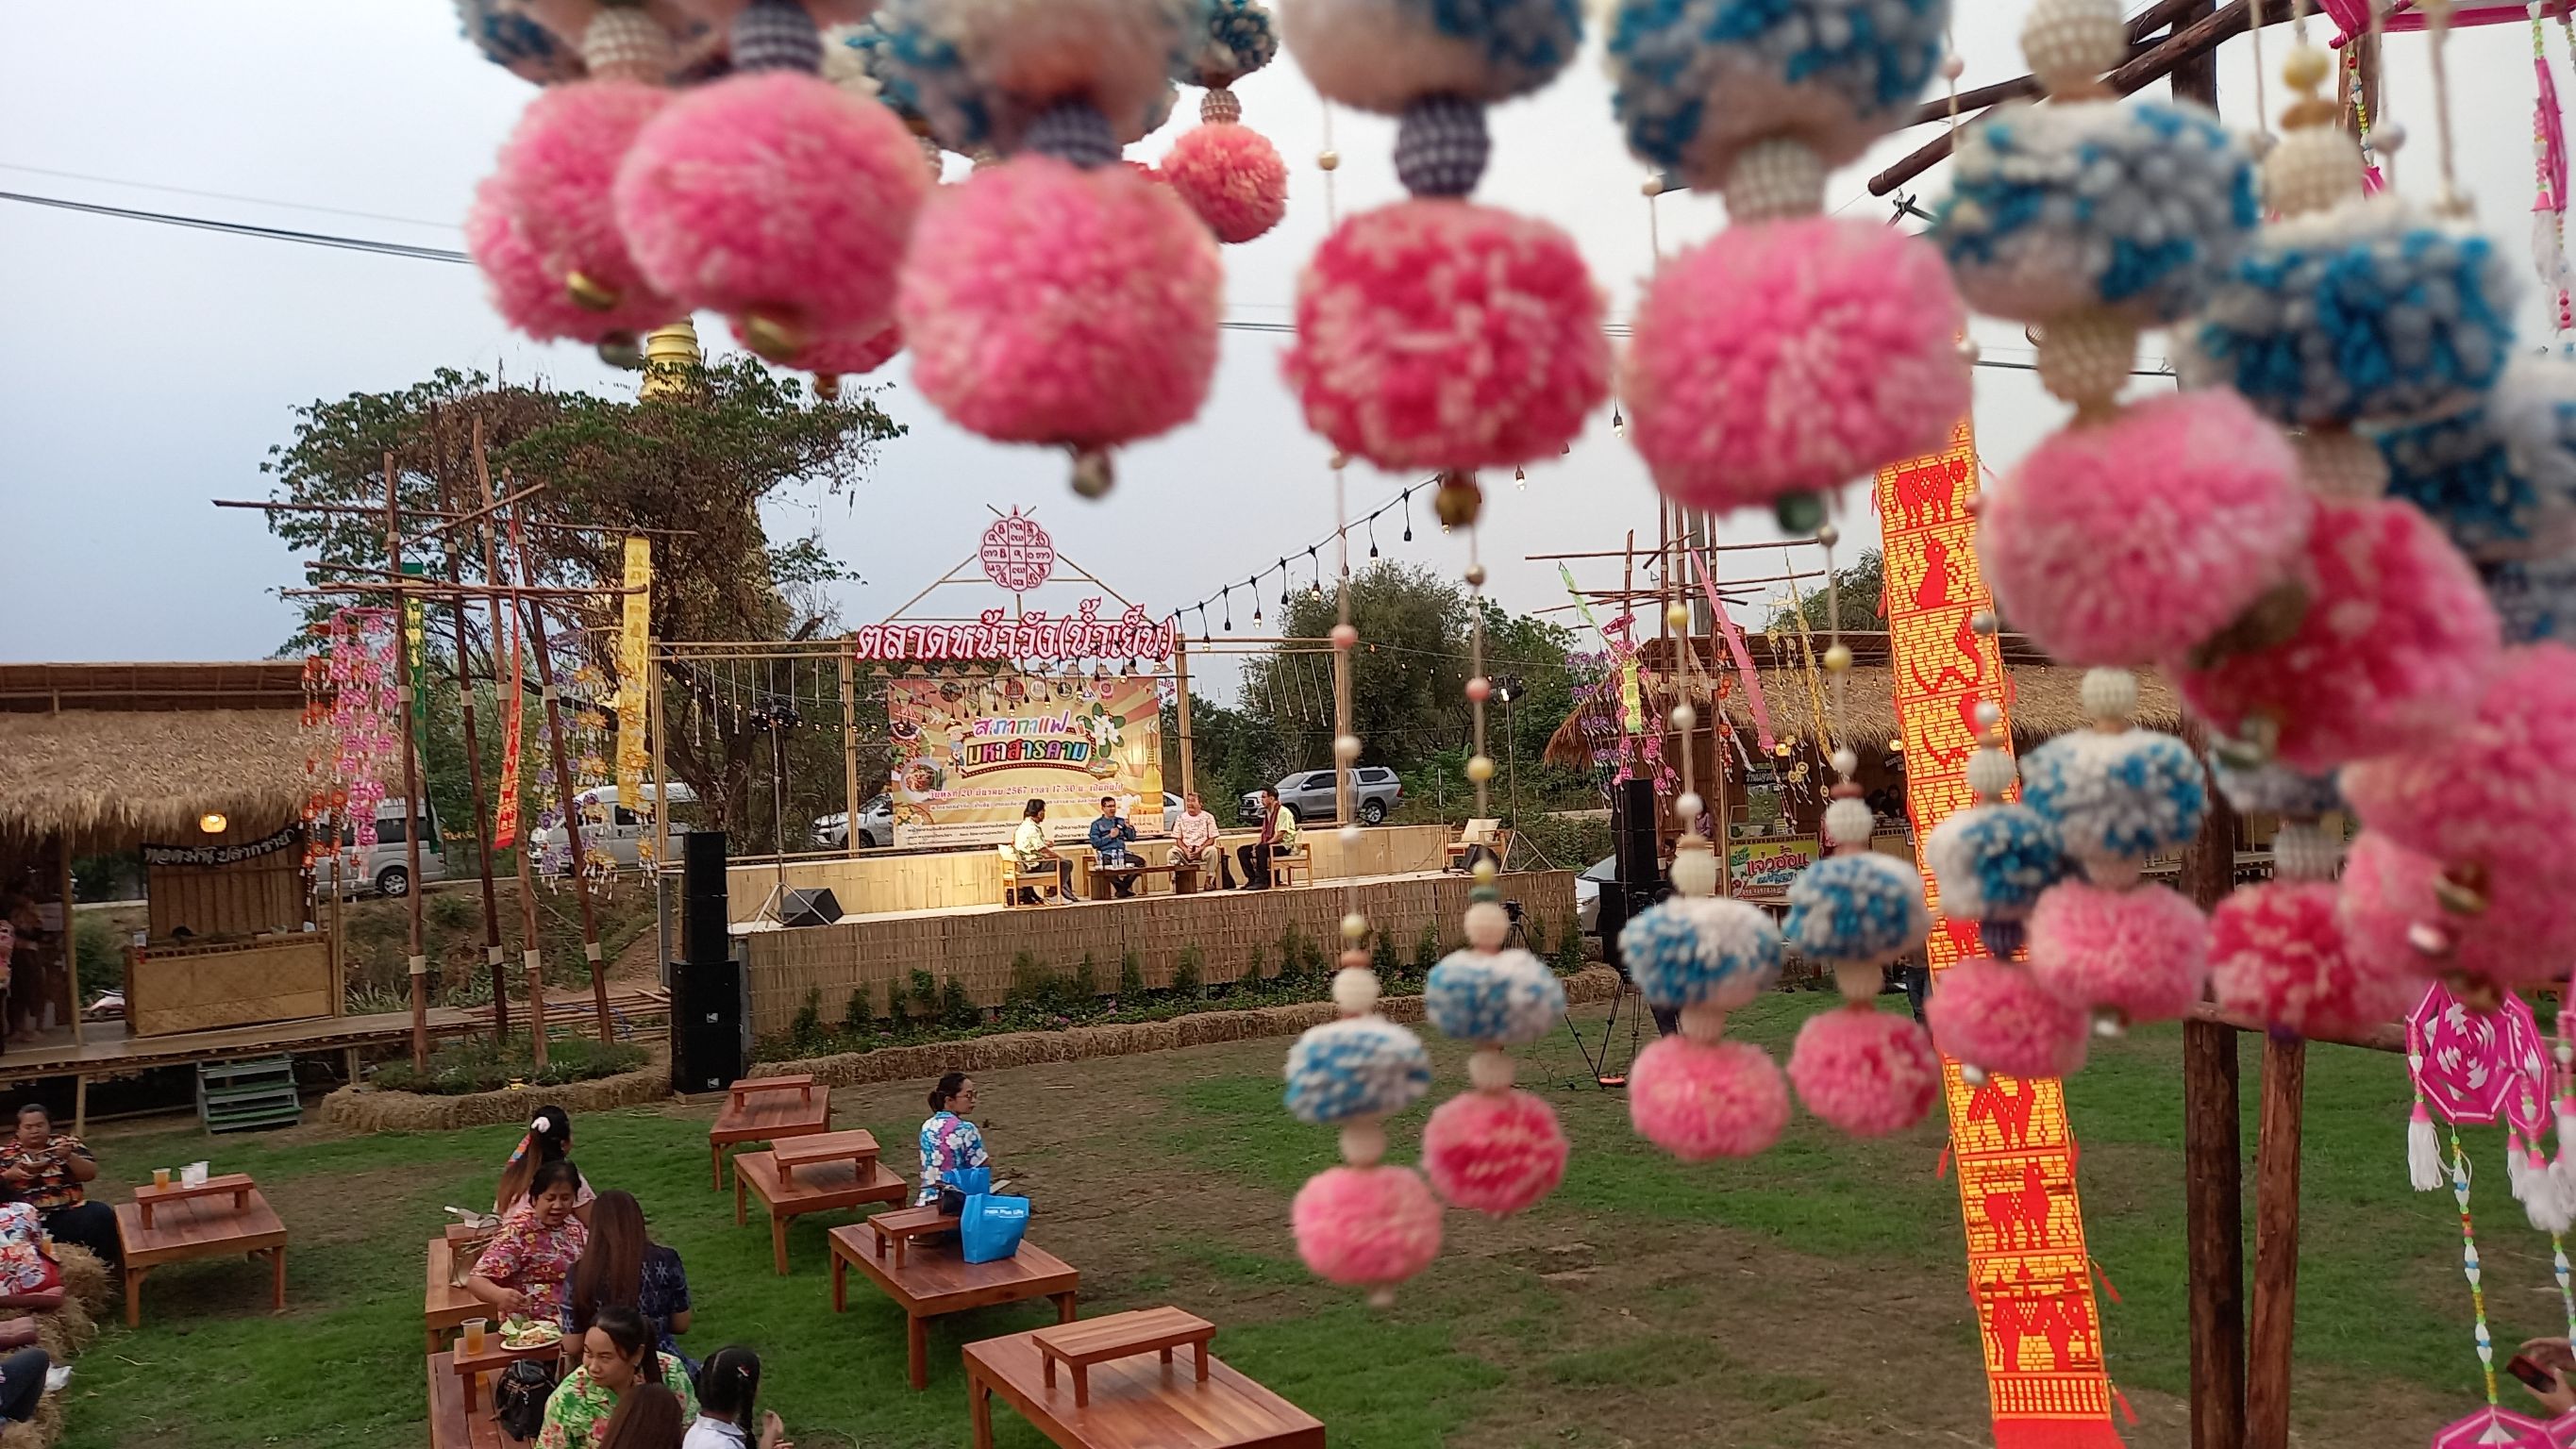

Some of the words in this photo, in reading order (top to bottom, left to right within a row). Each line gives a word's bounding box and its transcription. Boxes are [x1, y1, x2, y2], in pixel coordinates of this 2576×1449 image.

[857, 597, 1176, 661] ตลาดหน้าวัง(น้ำเย็น)
[973, 709, 1070, 736] สภากาแฟ
[965, 739, 1089, 767] มหาสารคาม
[1006, 786, 1028, 796] 2567
